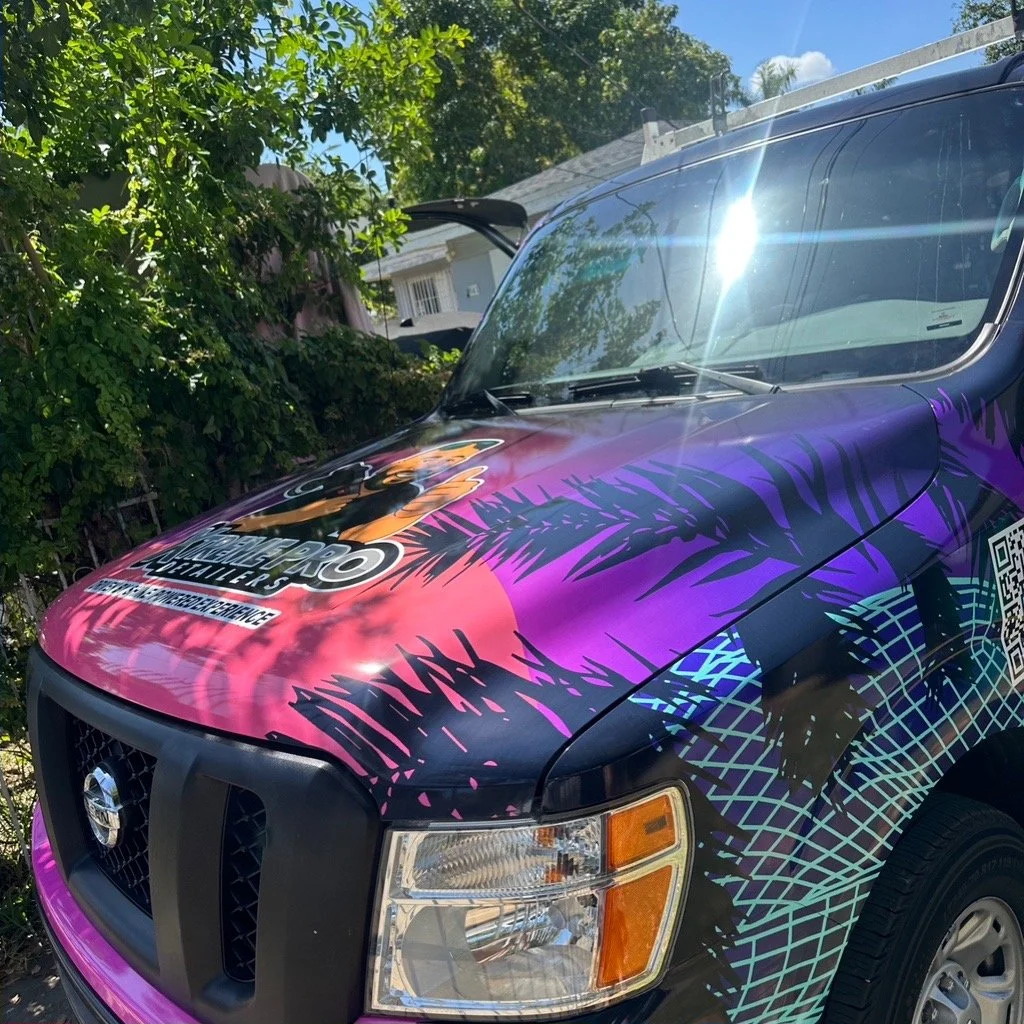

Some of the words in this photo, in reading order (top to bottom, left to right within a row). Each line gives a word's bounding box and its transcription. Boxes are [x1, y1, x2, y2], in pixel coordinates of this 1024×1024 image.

[157, 526, 299, 568] XTREME
[259, 540, 385, 583] PRO
[156, 561, 289, 590] DETAILERS
[188, 597, 278, 627] EXPERIENCE
